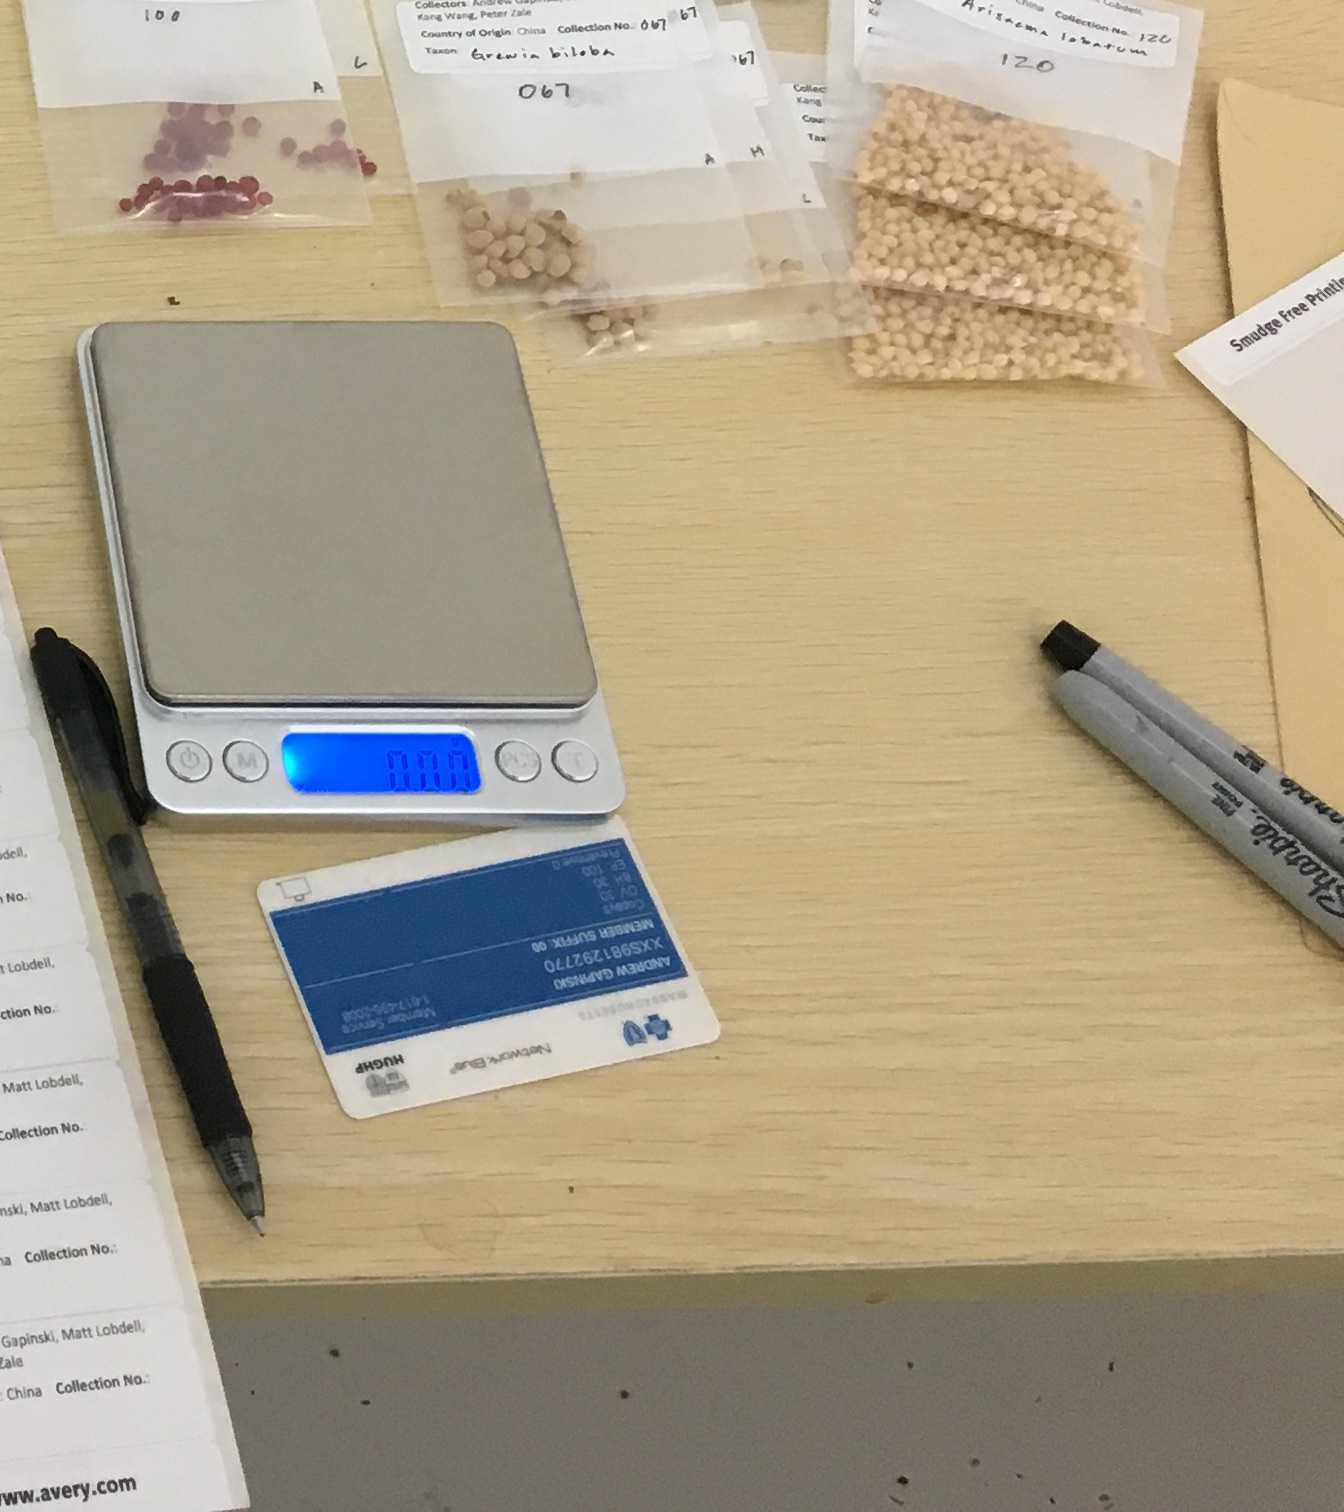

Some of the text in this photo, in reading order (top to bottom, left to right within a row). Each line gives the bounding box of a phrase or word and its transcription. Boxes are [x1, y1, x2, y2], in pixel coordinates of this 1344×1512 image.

[145, 9, 181, 22] 100
[640, 18, 667, 33] 067
[550, 47, 616, 59] biloba
[1000, 52, 1056, 74] 120
[313, 81, 324, 94] A
[518, 82, 572, 100] 067
[1230, 277, 1344, 352] Smudge Free Printi
[235, 752, 258, 768] M
[553, 956, 671, 990] ANDREW GAPINSKI
[488, 1042, 552, 1065] Network
[355, 1054, 405, 1074] HUGHP
[1, 1332, 58, 1350] Gapinski,
[61, 1327, 94, 1342] Matt
[96, 1320, 146, 1337] Lobdell,
[6, 1386, 42, 1401] China
[56, 1377, 120, 1395] Collection
